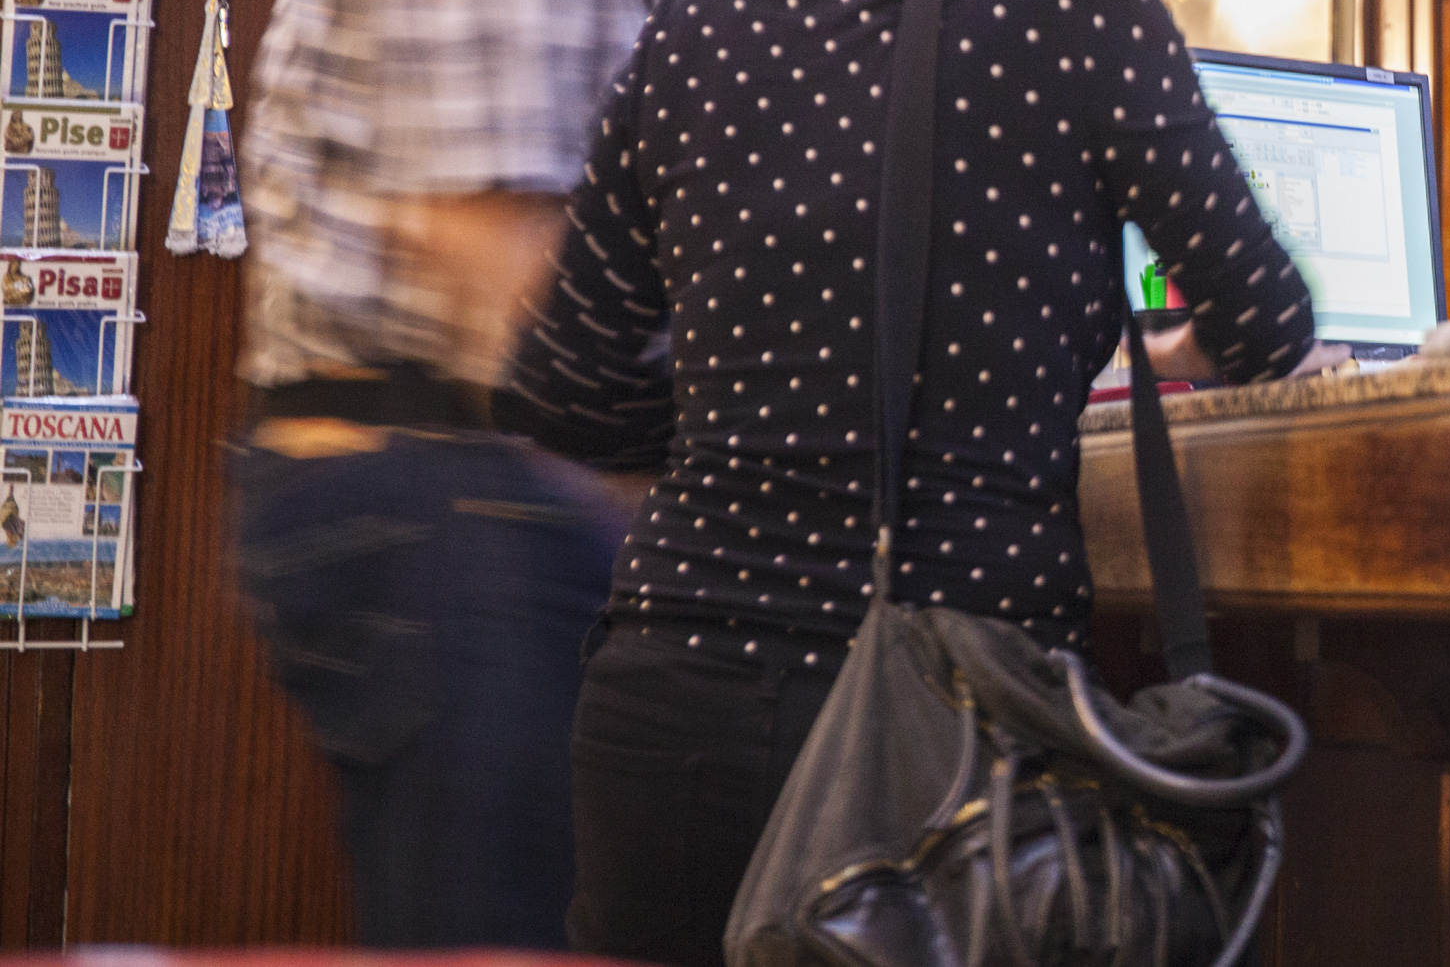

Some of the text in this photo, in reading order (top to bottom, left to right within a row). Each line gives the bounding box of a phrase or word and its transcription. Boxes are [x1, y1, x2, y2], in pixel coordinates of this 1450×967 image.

[40, 116, 104, 146] Pise
[38, 268, 98, 297] Pisa
[8, 413, 123, 441] TOSCANA
